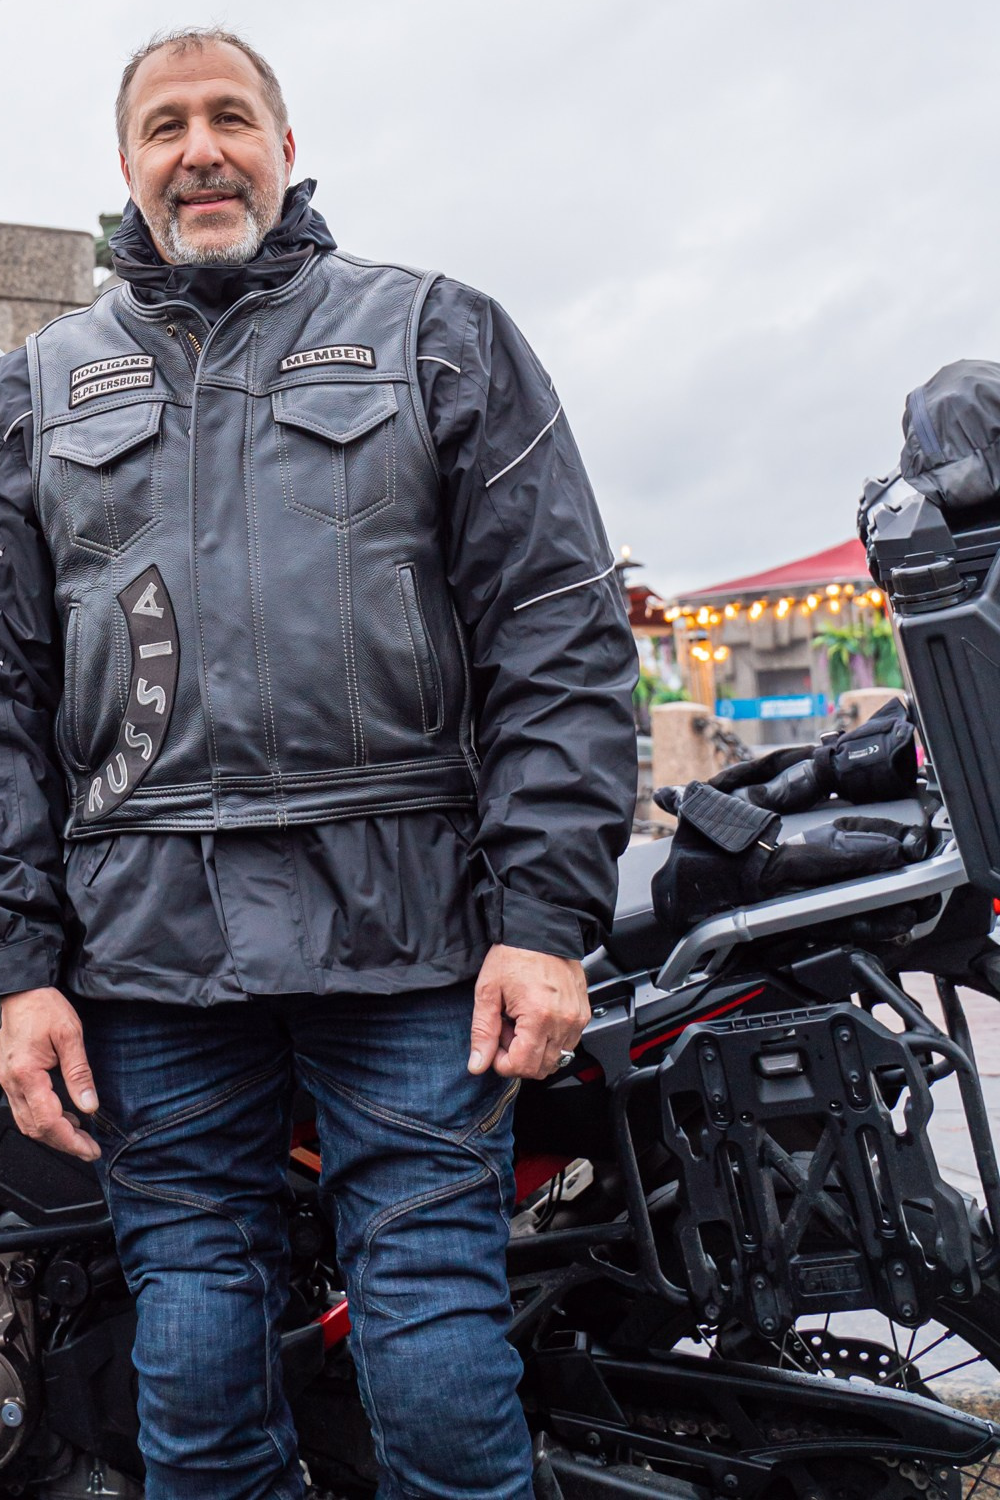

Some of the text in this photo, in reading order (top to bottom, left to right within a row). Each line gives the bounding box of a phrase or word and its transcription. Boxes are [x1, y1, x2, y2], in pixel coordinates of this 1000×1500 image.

[73, 357, 149, 383] HOOLIGANS
[286, 348, 368, 367] MEMBER
[88, 581, 173, 813] RUSSIA
